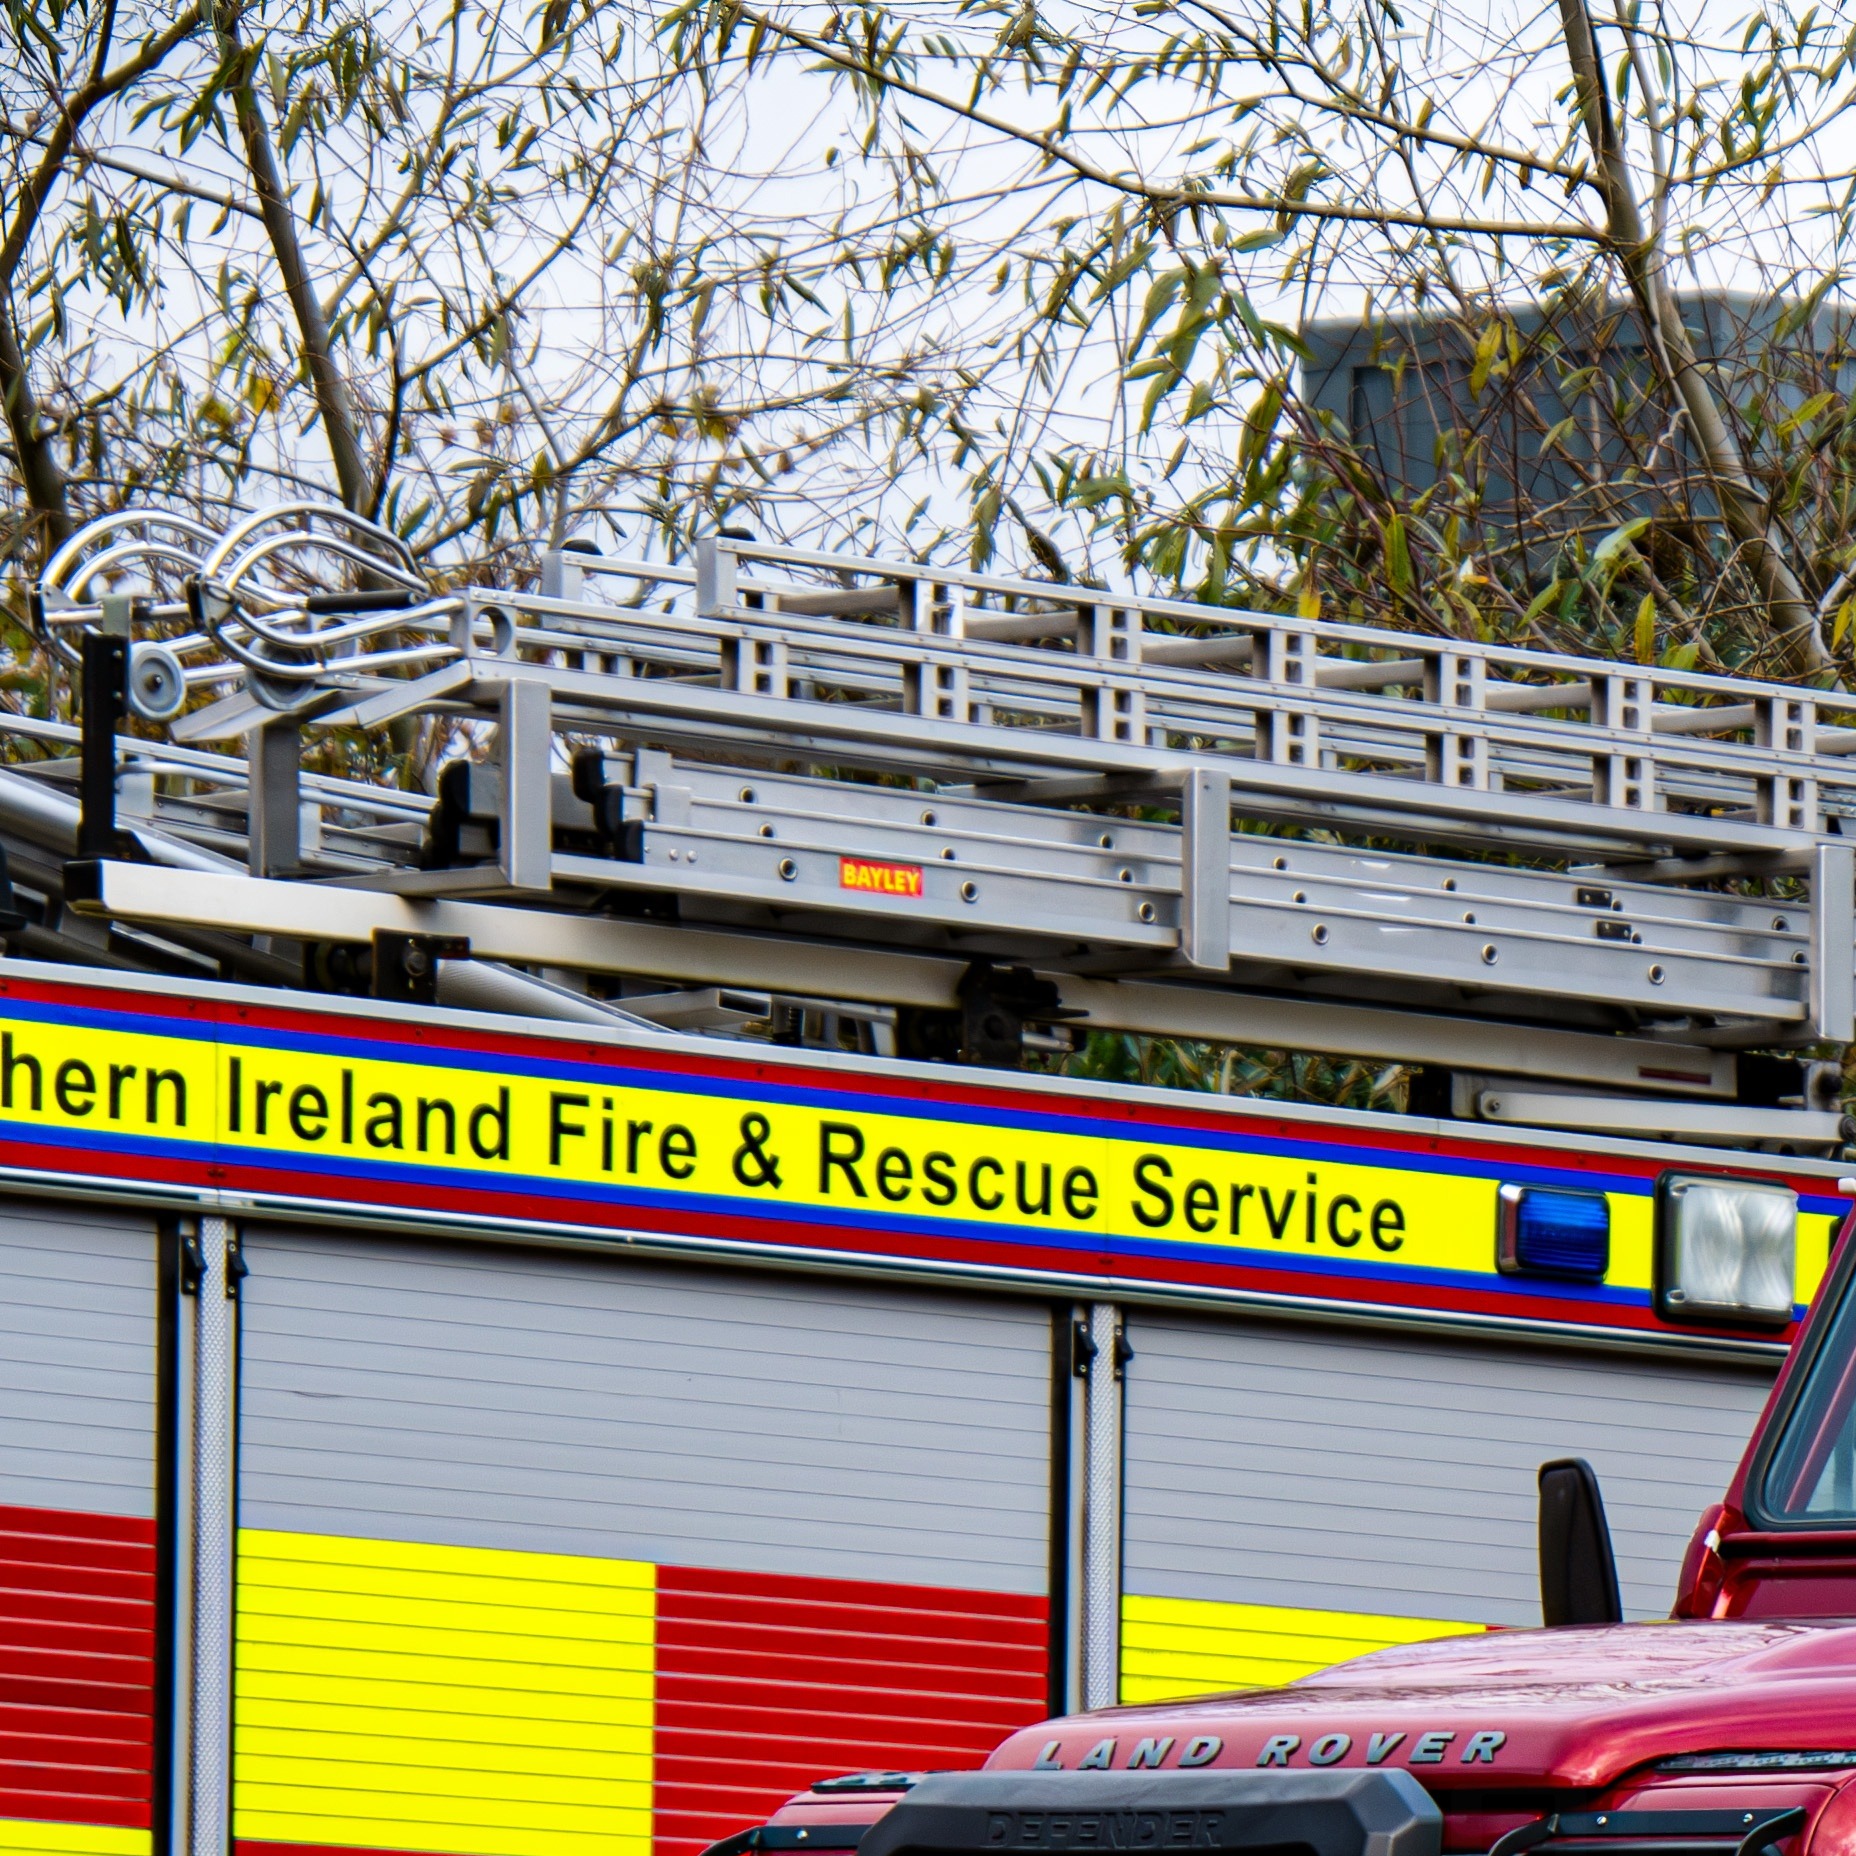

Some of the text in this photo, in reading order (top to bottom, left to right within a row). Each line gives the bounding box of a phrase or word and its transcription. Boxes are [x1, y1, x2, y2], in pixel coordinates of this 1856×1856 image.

[842, 862, 920, 893] BAYLEY
[228, 1055, 511, 1162] Ireland
[548, 1090, 699, 1181] Fire
[731, 1111, 784, 1191] &
[818, 1120, 1100, 1222] Rescue
[1131, 1153, 1407, 1254] Service
[1033, 1730, 1508, 1771] LAND ROVER
[979, 1810, 1226, 1850] DEFENDER
